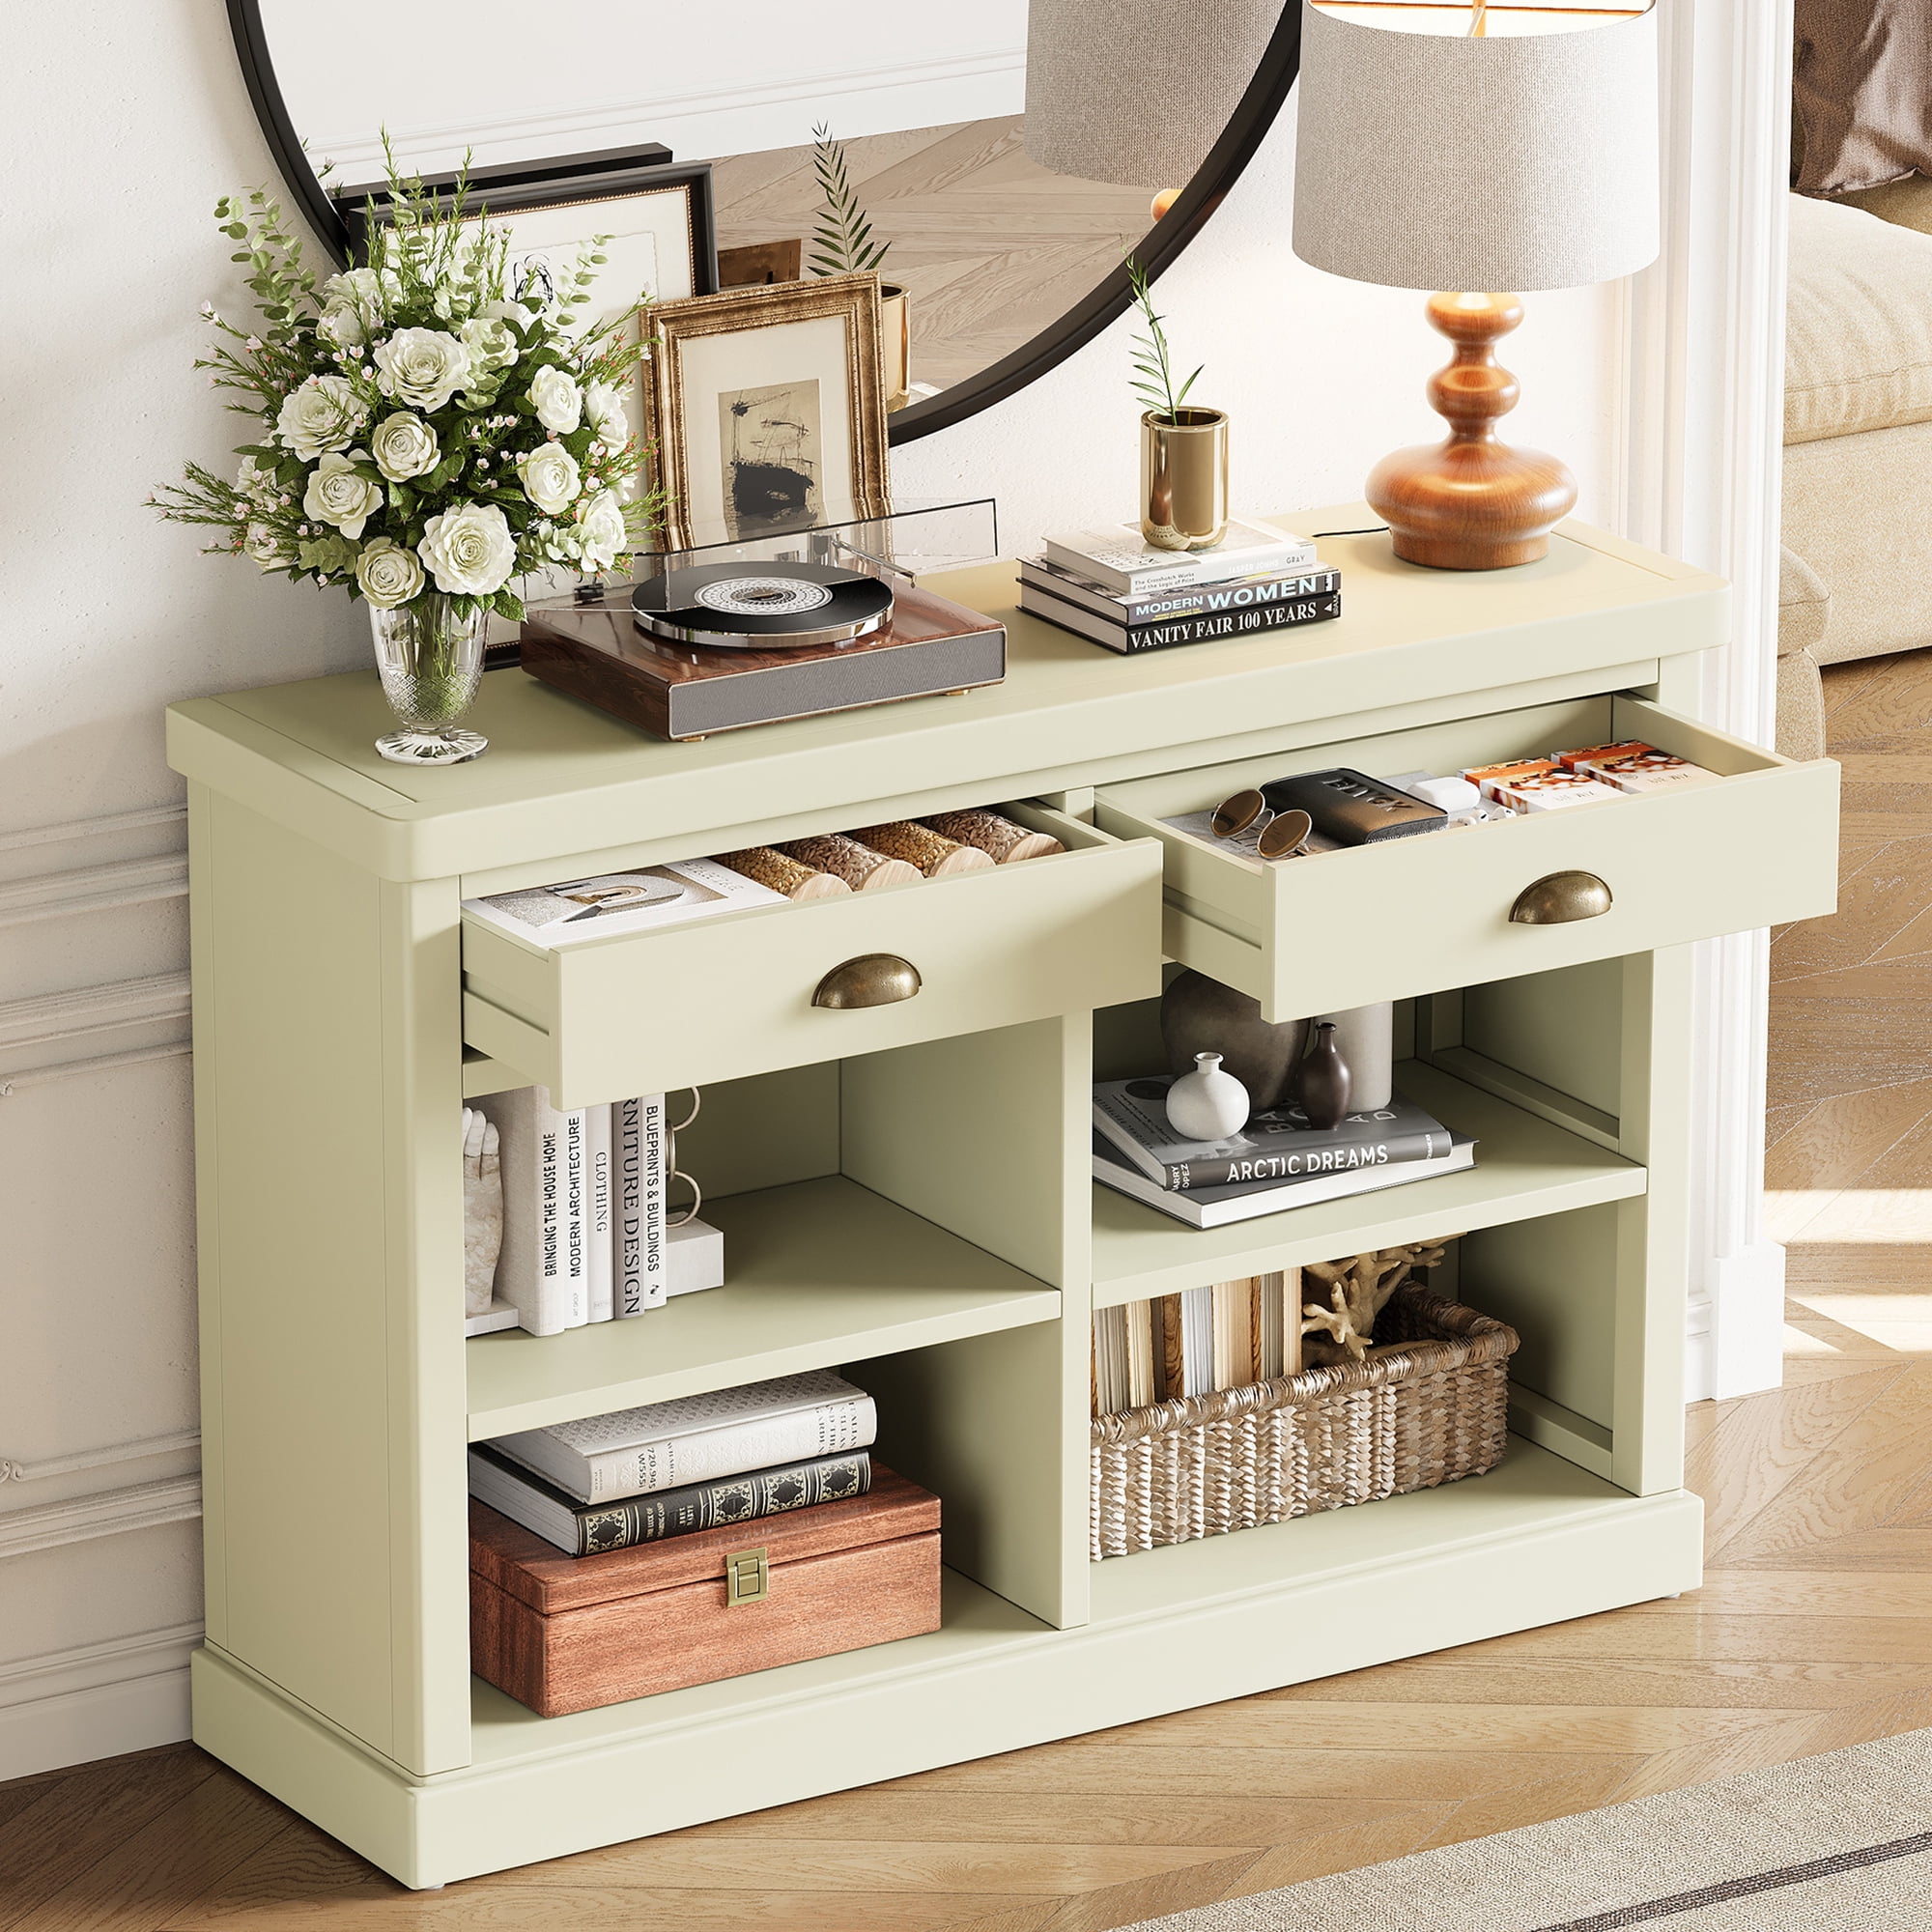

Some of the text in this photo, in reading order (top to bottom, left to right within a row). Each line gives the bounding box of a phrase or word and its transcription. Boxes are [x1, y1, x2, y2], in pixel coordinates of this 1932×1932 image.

[1286, 554, 1305, 564] GRAY
[1135, 595, 1204, 616] MODERN
[1208, 577, 1317, 610] WOMEN
[1130, 624, 1191, 648] VANITY
[1196, 616, 1234, 639] FAIR
[1237, 611, 1261, 631] 100
[1264, 602, 1317, 626] YEARS
[568, 1117, 581, 1217] ARCHITECTURE
[1171, 1165, 1180, 1191] ARRY
[1180, 1162, 1190, 1188] OPEZ
[1226, 1145, 1388, 1182] ARCTIC DREAMS
[543, 1132, 557, 1277] BRINGING THE HOUSE HOME
[595, 1151, 607, 1232] CLOTHING
[646, 1105, 660, 1272] BLUEPRINTS & BUILDINGS
[569, 1221, 582, 1277] MODERN
[624, 1217, 640, 1315] DESIGN
[647, 1447, 657, 1490] 720.945
